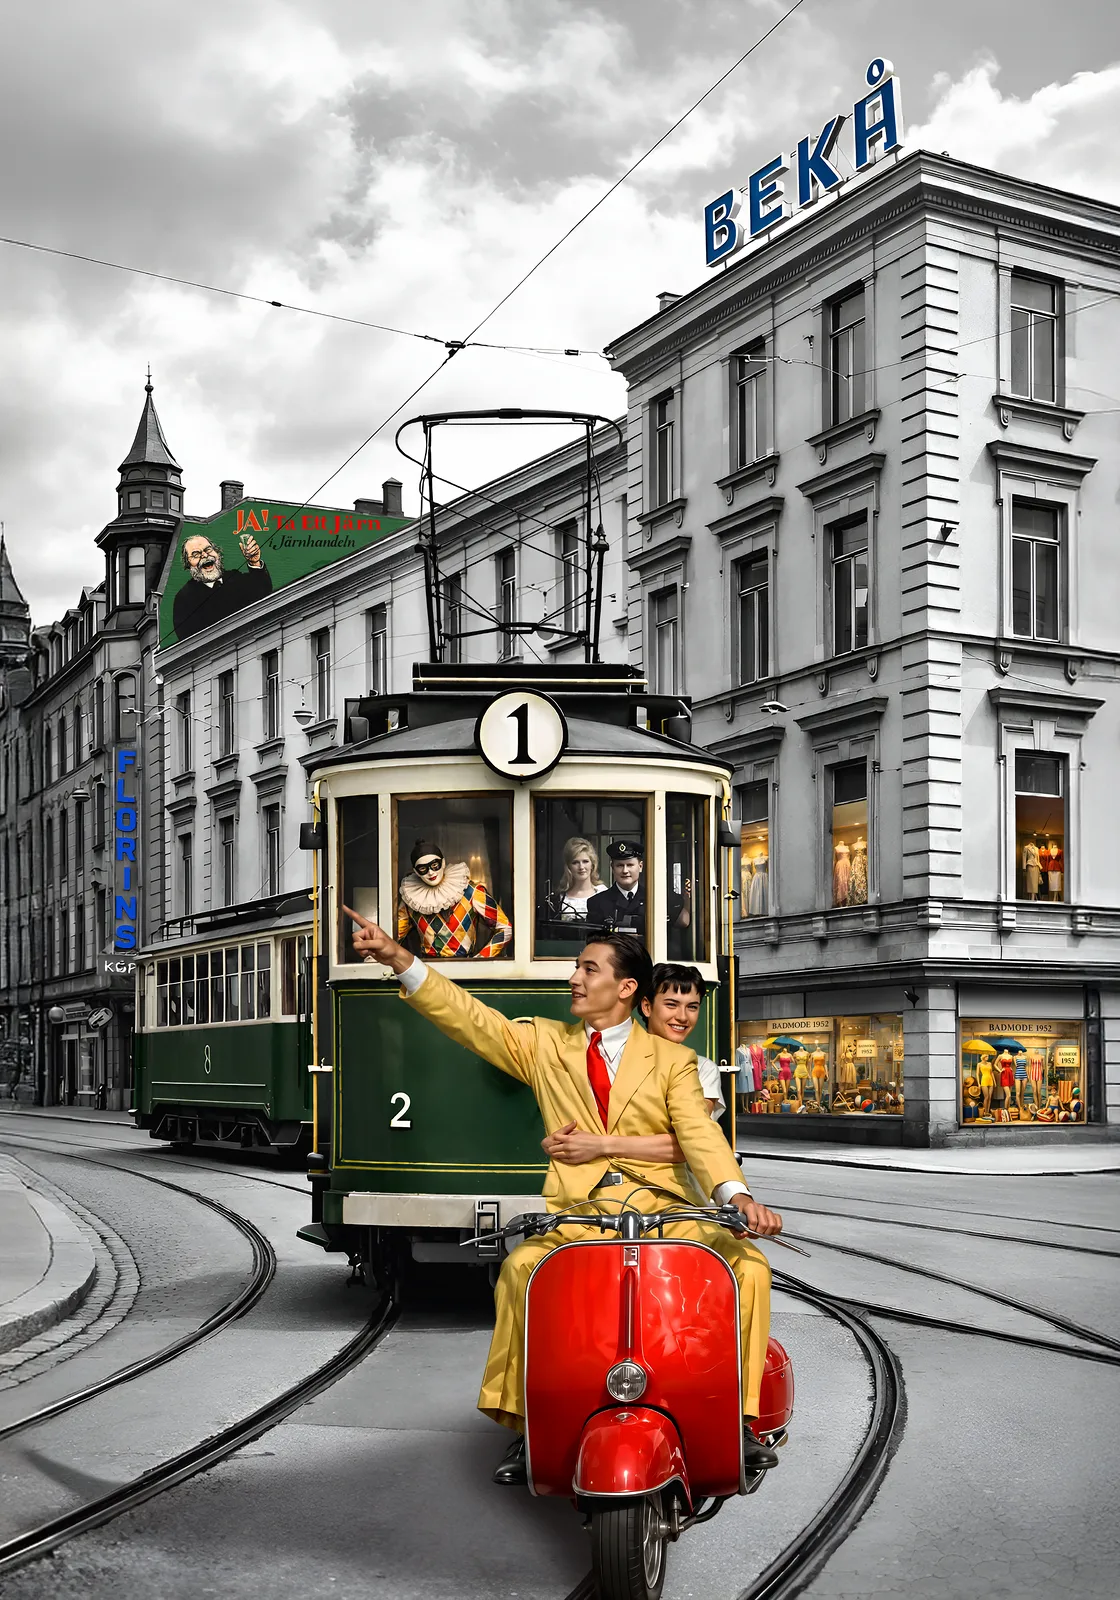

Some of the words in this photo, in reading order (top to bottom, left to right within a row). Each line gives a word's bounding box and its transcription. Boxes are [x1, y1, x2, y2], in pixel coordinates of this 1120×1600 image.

[703, 57, 904, 267] BEKÅ
[233, 509, 269, 535] JA!
[272, 515, 296, 531] Ta
[301, 515, 327, 531] Ett
[329, 514, 382, 535] Järn
[269, 537, 274, 548] i
[273, 534, 356, 550] Järnhandeln
[506, 702, 537, 764] 1
[114, 750, 137, 949] FLORINS
[772, 1021, 811, 1030] BADMODE
[813, 1020, 829, 1028] 1952
[988, 1023, 1034, 1031] BADMODE
[1036, 1024, 1052, 1032] 1952
[204, 1044, 211, 1074] 8
[390, 1091, 412, 1128] 2
